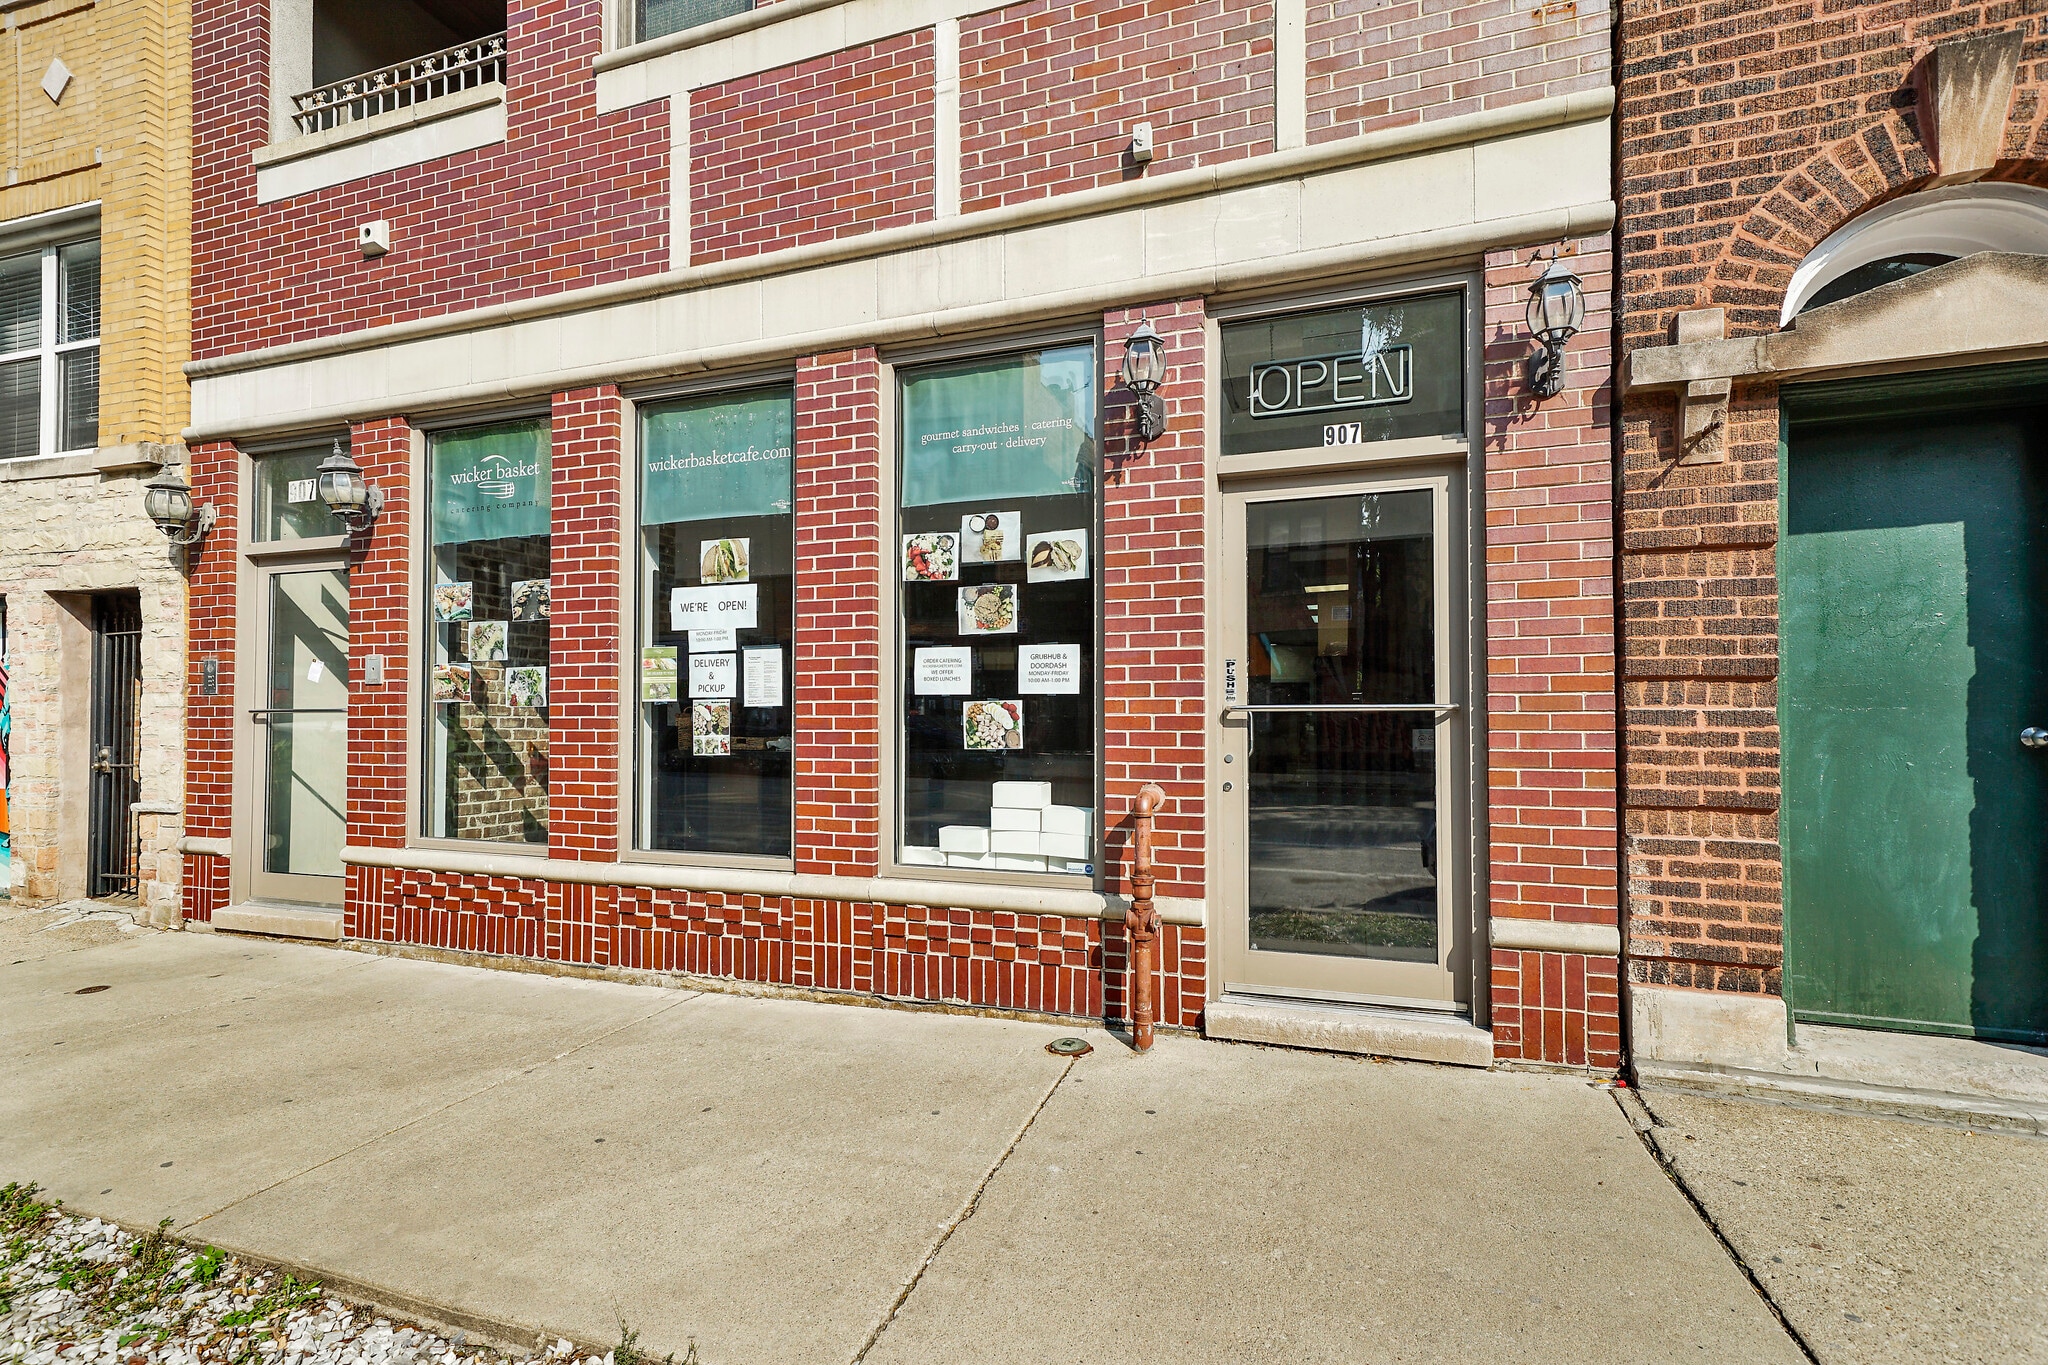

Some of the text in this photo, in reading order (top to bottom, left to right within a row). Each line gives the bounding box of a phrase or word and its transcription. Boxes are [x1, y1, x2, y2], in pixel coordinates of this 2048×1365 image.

[1258, 349, 1404, 410] OPEN
[921, 417, 1073, 445] gourmet sandwiches catering
[1325, 423, 1361, 446] 907
[952, 435, 1047, 454] carry-out delivery
[648, 445, 792, 473] wickerbasketcafe.com
[450, 460, 541, 485] wicker basket
[450, 500, 540, 514] catering company
[680, 600, 747, 612] WE'RE OPEN!
[694, 658, 730, 668] DELIVERY
[708, 671, 715, 680] &
[1226, 661, 1236, 688] PUSH
[697, 684, 726, 693] PICKUP
